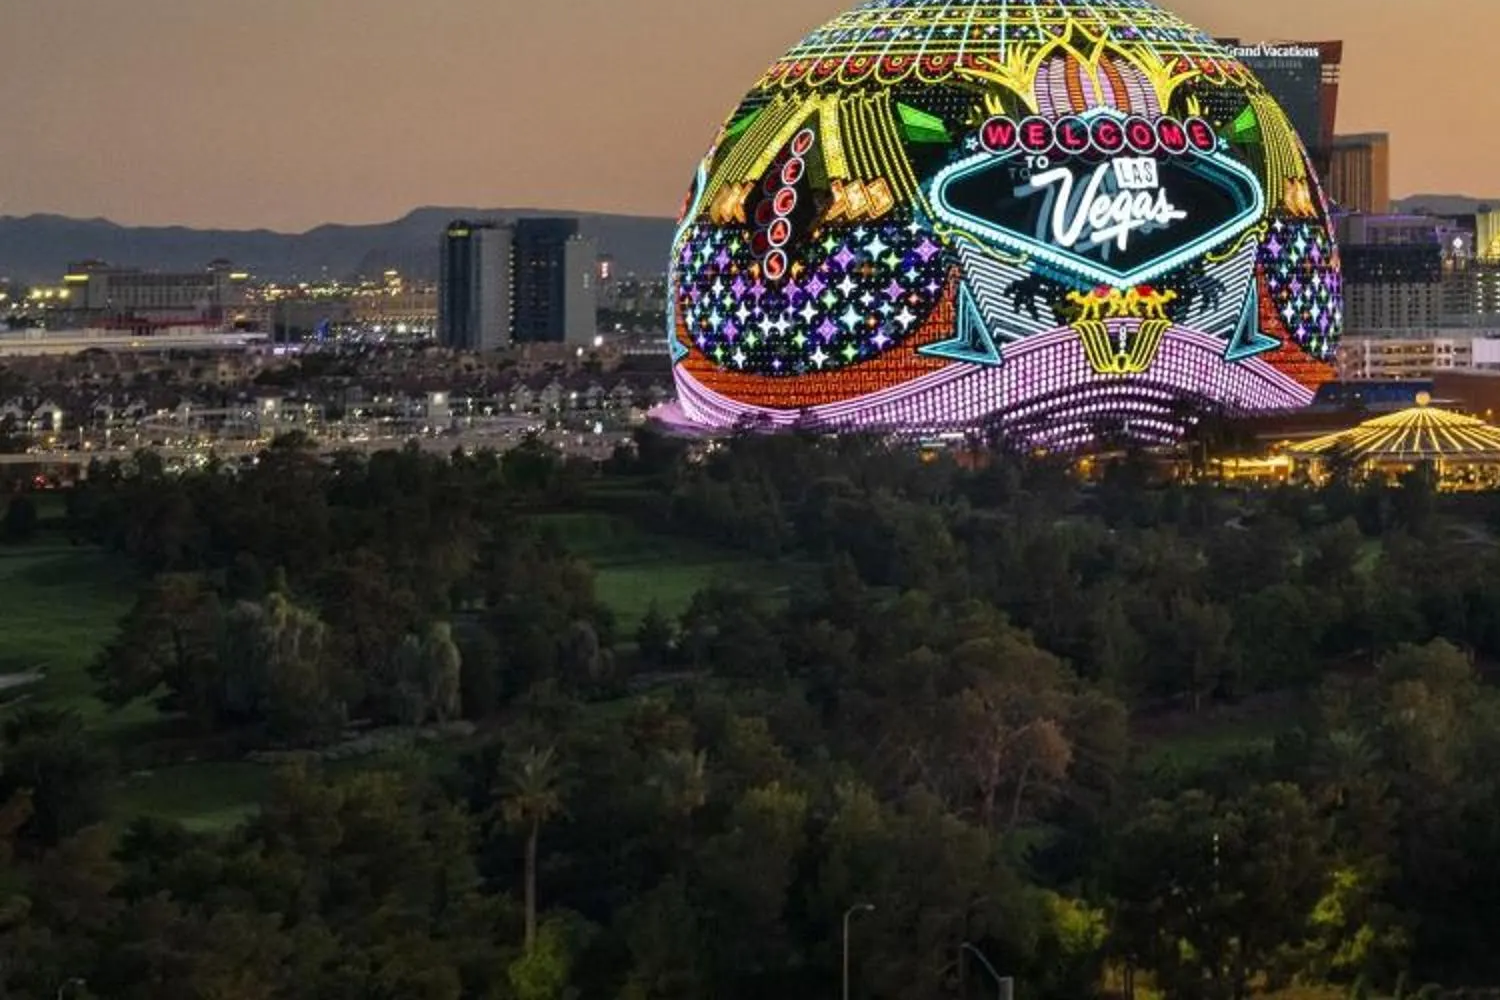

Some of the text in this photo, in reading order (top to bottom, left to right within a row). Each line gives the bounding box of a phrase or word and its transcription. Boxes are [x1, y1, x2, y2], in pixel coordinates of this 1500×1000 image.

[1261, 42, 1319, 57] Vacations
[986, 121, 1209, 147] WELCOME
[1025, 155, 1049, 169] TO
[1118, 161, 1153, 184] LAS
[767, 131, 813, 276] VEGAS
[1030, 162, 1187, 251] Vegas
